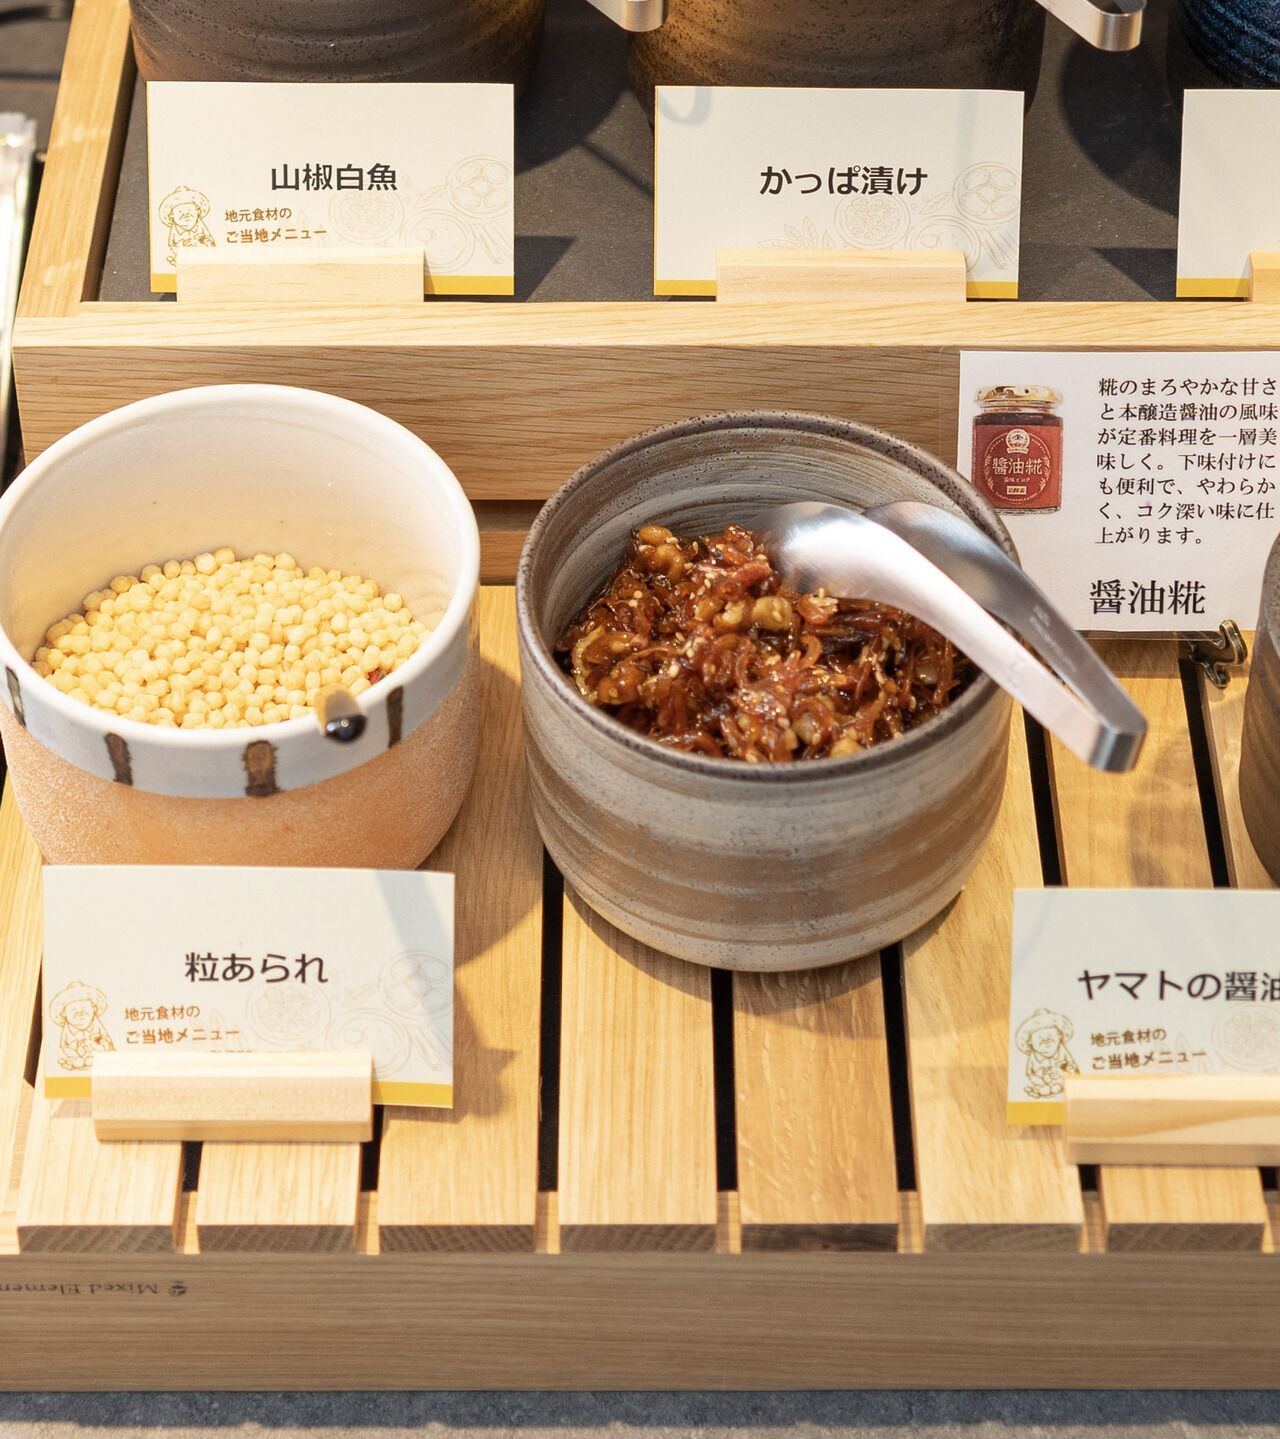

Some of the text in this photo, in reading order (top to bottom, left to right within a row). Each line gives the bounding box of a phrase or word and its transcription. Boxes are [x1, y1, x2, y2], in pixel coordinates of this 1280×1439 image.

[270, 164, 398, 192] 山椒白魚
[759, 165, 929, 197] かっぱ漬け
[224, 207, 293, 223] 地元食材の
[226, 227, 327, 245] ご当地メニュー
[1099, 378, 1277, 396] 糀のまろやかな甘さ
[1100, 403, 1278, 421] と本醸造醤油の風味
[1098, 428, 1277, 446] が定番料理を一層美
[1096, 453, 1276, 471] 味しく。下味付けに
[1099, 478, 1276, 496] も便利で、やわらか
[1099, 503, 1274, 520] く、コク深い味に仕
[1095, 527, 1204, 545] 上がります。
[1089, 579, 1205, 616] 醤油糀
[185, 952, 328, 983] 粒あられ
[125, 1005, 200, 1021] 地元食材の
[126, 1028, 240, 1044] ご当地メニュー
[1090, 1028, 1167, 1046] 地元食材の
[1091, 1049, 1207, 1071] ご当地メニュー
